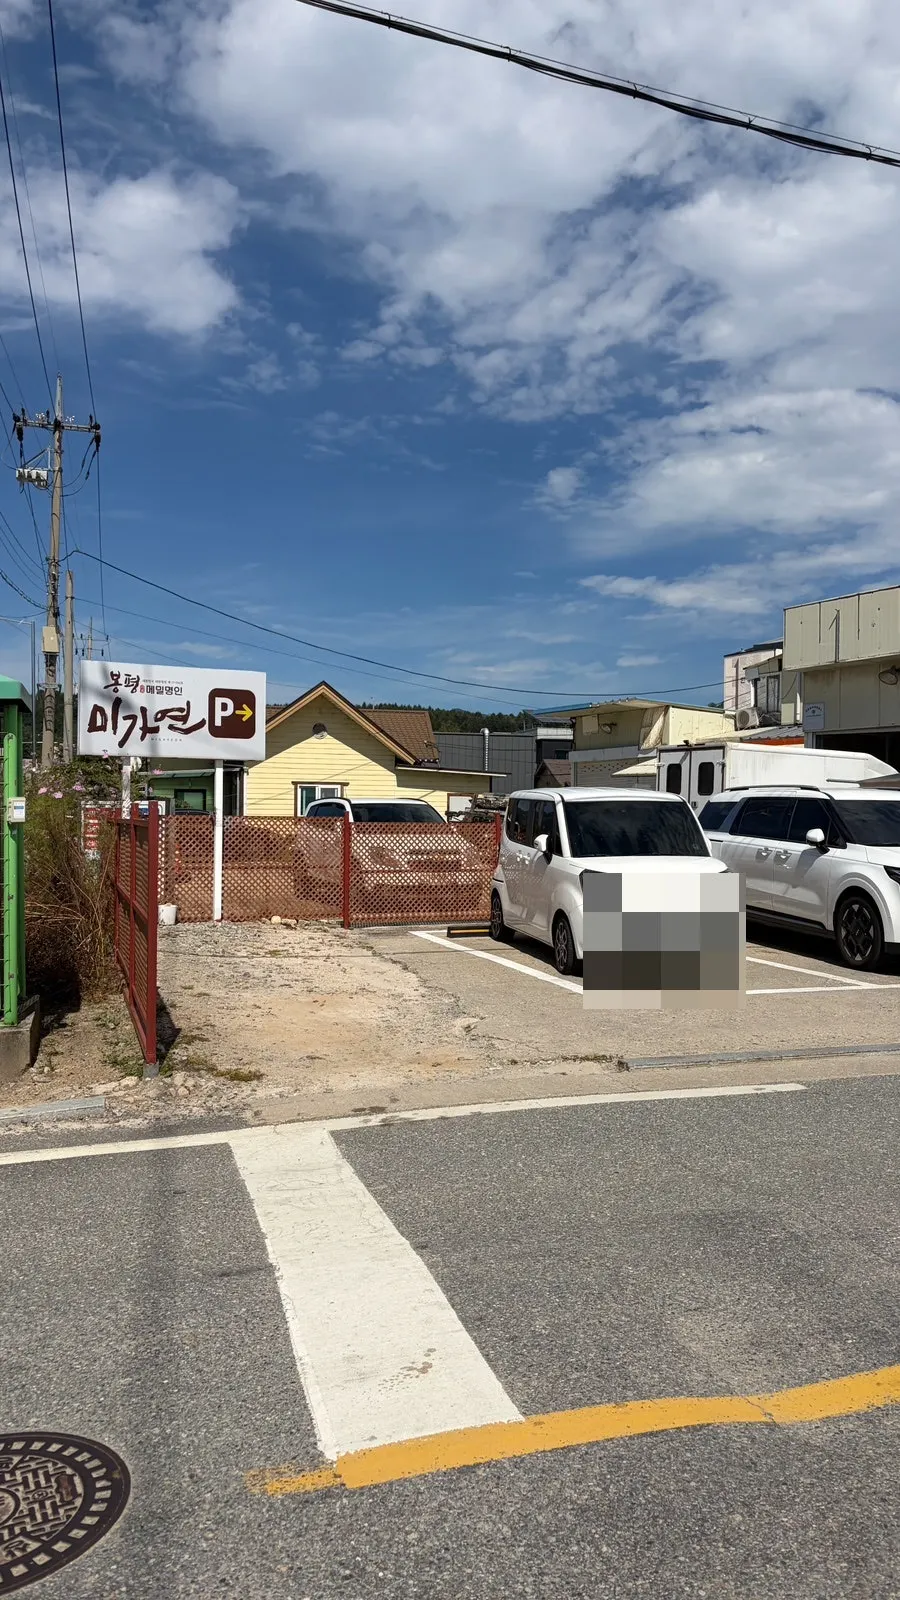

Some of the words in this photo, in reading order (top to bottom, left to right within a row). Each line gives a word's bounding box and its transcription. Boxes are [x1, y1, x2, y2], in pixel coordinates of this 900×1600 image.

[103, 670, 140, 694] 봉평
[146, 685, 183, 696] 메밀명인
[87, 696, 207, 748] 미가연
[214, 696, 234, 727] P
